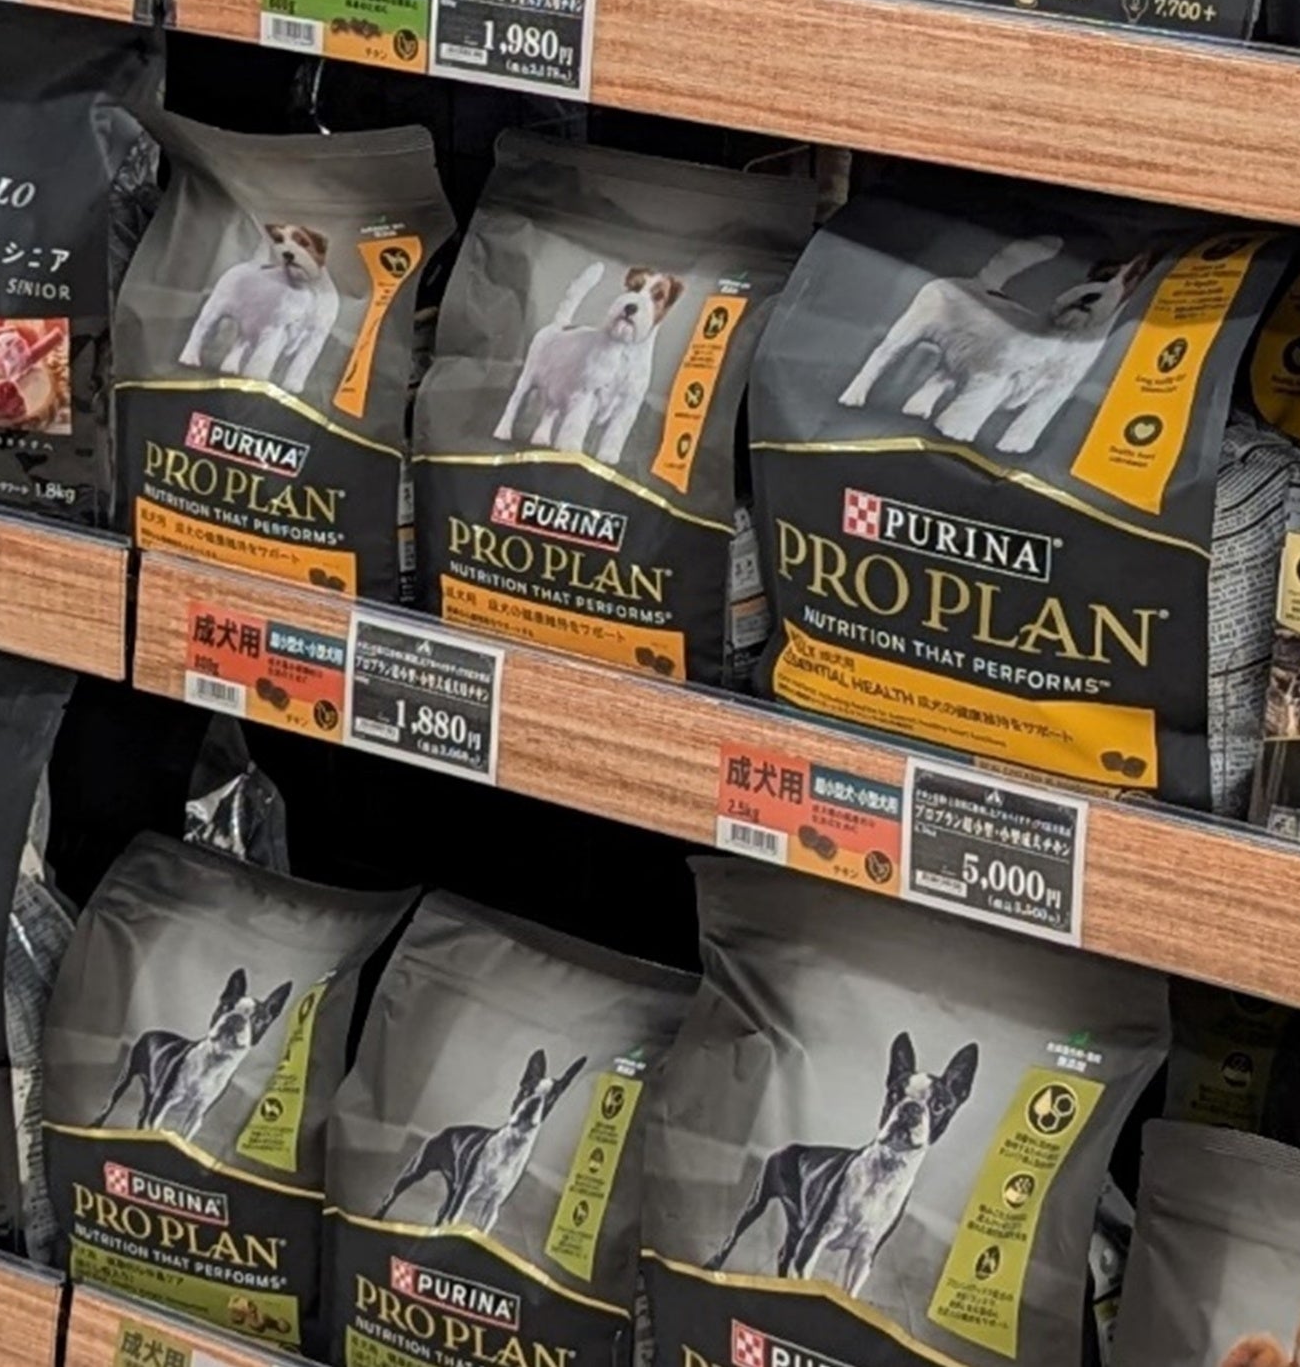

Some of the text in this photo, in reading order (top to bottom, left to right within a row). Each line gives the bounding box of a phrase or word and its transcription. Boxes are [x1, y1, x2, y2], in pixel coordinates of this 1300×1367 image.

[481, 20, 574, 64] 1,980円
[3, 241, 71, 272] シニア
[209, 426, 302, 470] PURINA
[33, 479, 77, 504] 1.8kg
[144, 441, 338, 524] PRO PLAN
[520, 501, 620, 543] PURINA
[884, 503, 1042, 575] PURINA
[448, 515, 664, 603] PRO PLAN
[449, 559, 665, 623] NUTRITION THAT PERFORMS
[777, 519, 1156, 668] PRO PLAN
[192, 614, 261, 660] 成犬用
[804, 607, 1100, 695] NUTRITION THAT PERFORMS
[851, 675, 916, 707] HEALTH
[395, 698, 482, 748] 1,880円
[727, 751, 805, 805] 成犬用
[961, 853, 1062, 909] 5,000円
[130, 1173, 222, 1220] PURINA
[72, 1182, 278, 1270] PRO PLAN
[355, 1275, 568, 1367] PRO PLAN
[416, 1272, 516, 1321] PURINA
